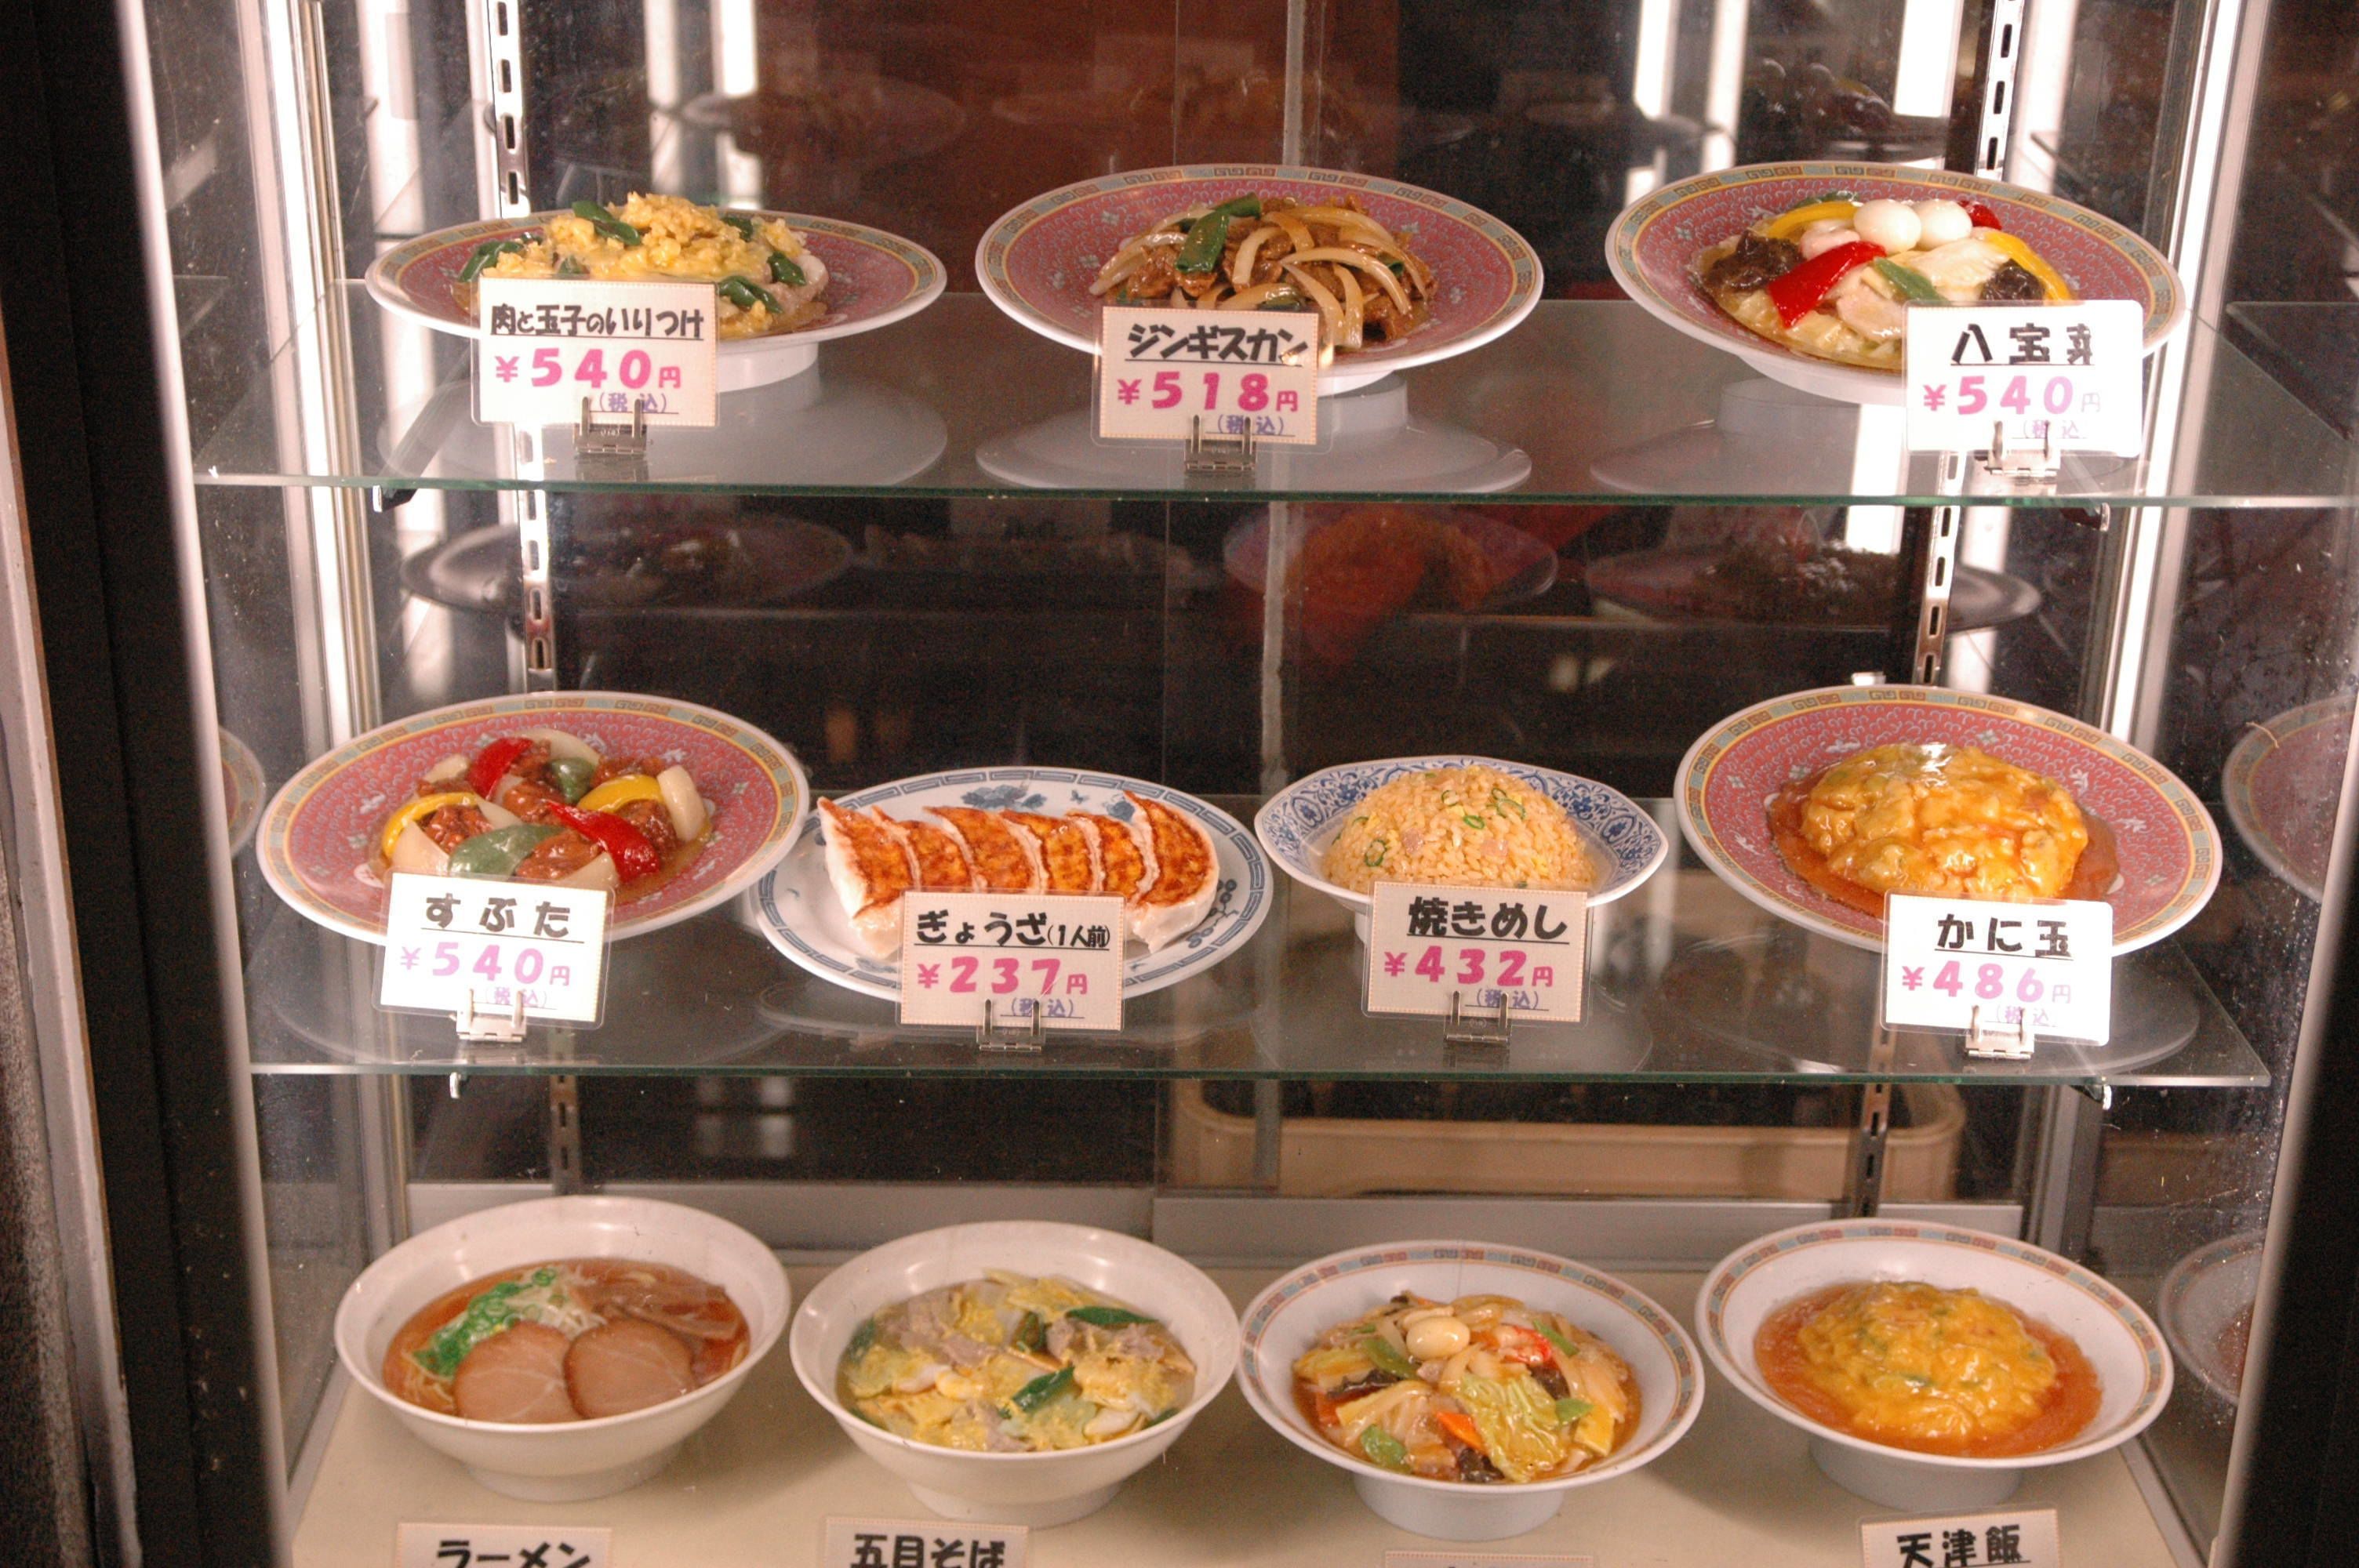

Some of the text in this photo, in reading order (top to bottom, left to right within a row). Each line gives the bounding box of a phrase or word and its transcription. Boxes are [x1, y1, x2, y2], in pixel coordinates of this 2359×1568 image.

[491, 303, 704, 337] 肉と玉子のいりつけ
[1128, 323, 1308, 364] ジンギスカン
[495, 347, 681, 389] ¥540円
[1117, 371, 1299, 412] ¥518円
[426, 893, 570, 938] すぶた
[1408, 896, 1568, 939] 焼きめし
[1936, 913, 2072, 958] かに玉
[400, 941, 571, 987] ¥540円
[917, 956, 1088, 996] ¥237円
[1383, 946, 1554, 988] ¥432円
[1902, 960, 2071, 1004] ¥486円
[438, 1540, 591, 1568] ラーメン
[850, 1534, 1005, 1568] 五目そば
[1896, 1525, 2023, 1568] 天津飯
